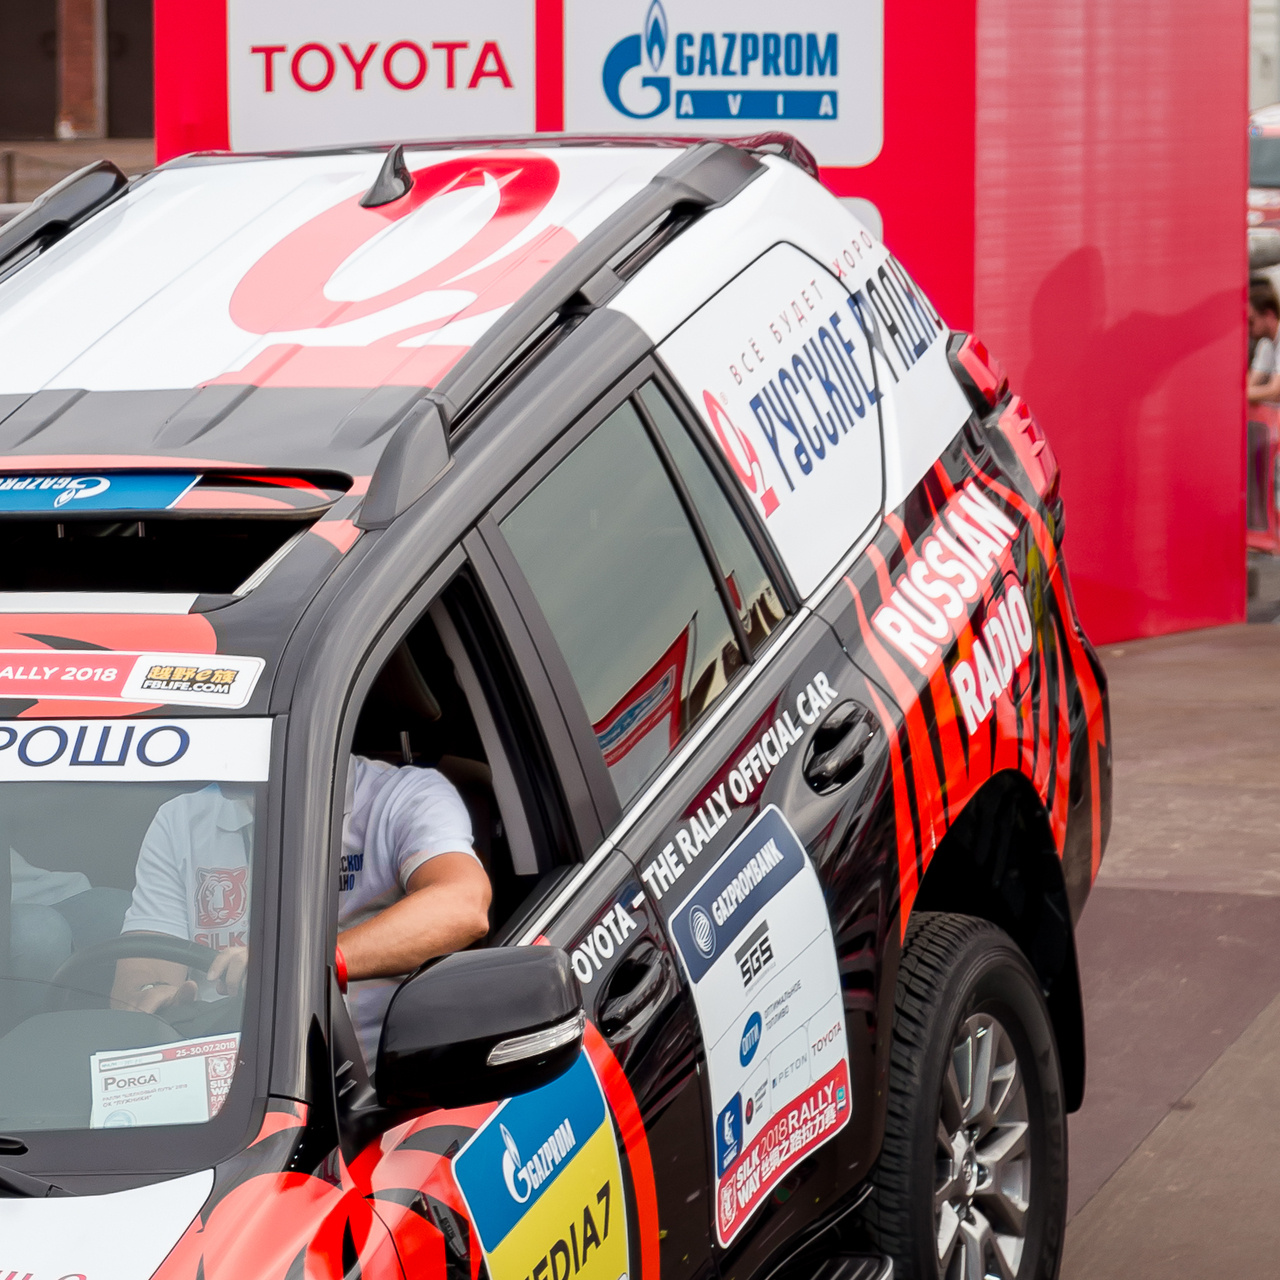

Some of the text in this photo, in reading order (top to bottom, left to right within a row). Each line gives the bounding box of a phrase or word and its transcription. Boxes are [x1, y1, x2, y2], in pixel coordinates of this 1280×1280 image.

[250, 40, 514, 94] TOYOTA
[676, 31, 838, 78] GAZPROM
[729, 337, 765, 386] ВСЁ
[769, 280, 824, 344] БУДЕТ
[749, 311, 884, 492] РУССКОЕ
[873, 481, 1018, 669] RUSSIAN
[60, 667, 119, 682] 2018
[142, 680, 231, 694] FBLIFE.COM
[950, 584, 1033, 736] RADIO
[571, 902, 637, 984] OYOTA
[641, 851, 686, 902] THE
[679, 790, 731, 865] RALLY
[727, 717, 803, 799] OFFICIAL
[796, 670, 839, 733] CAR
[712, 837, 785, 926] GAZPROMBANK
[176, 1041, 235, 1057] 25-30.07.2018
[811, 1021, 842, 1058] TOYOTA
[778, 1055, 808, 1082] PETON
[761, 1118, 788, 1160] 2018
[787, 1079, 836, 1134] RALLY
[528, 1117, 577, 1193] GAZPROM
[736, 1145, 760, 1187] SILK
[737, 1166, 761, 1209] WAY
